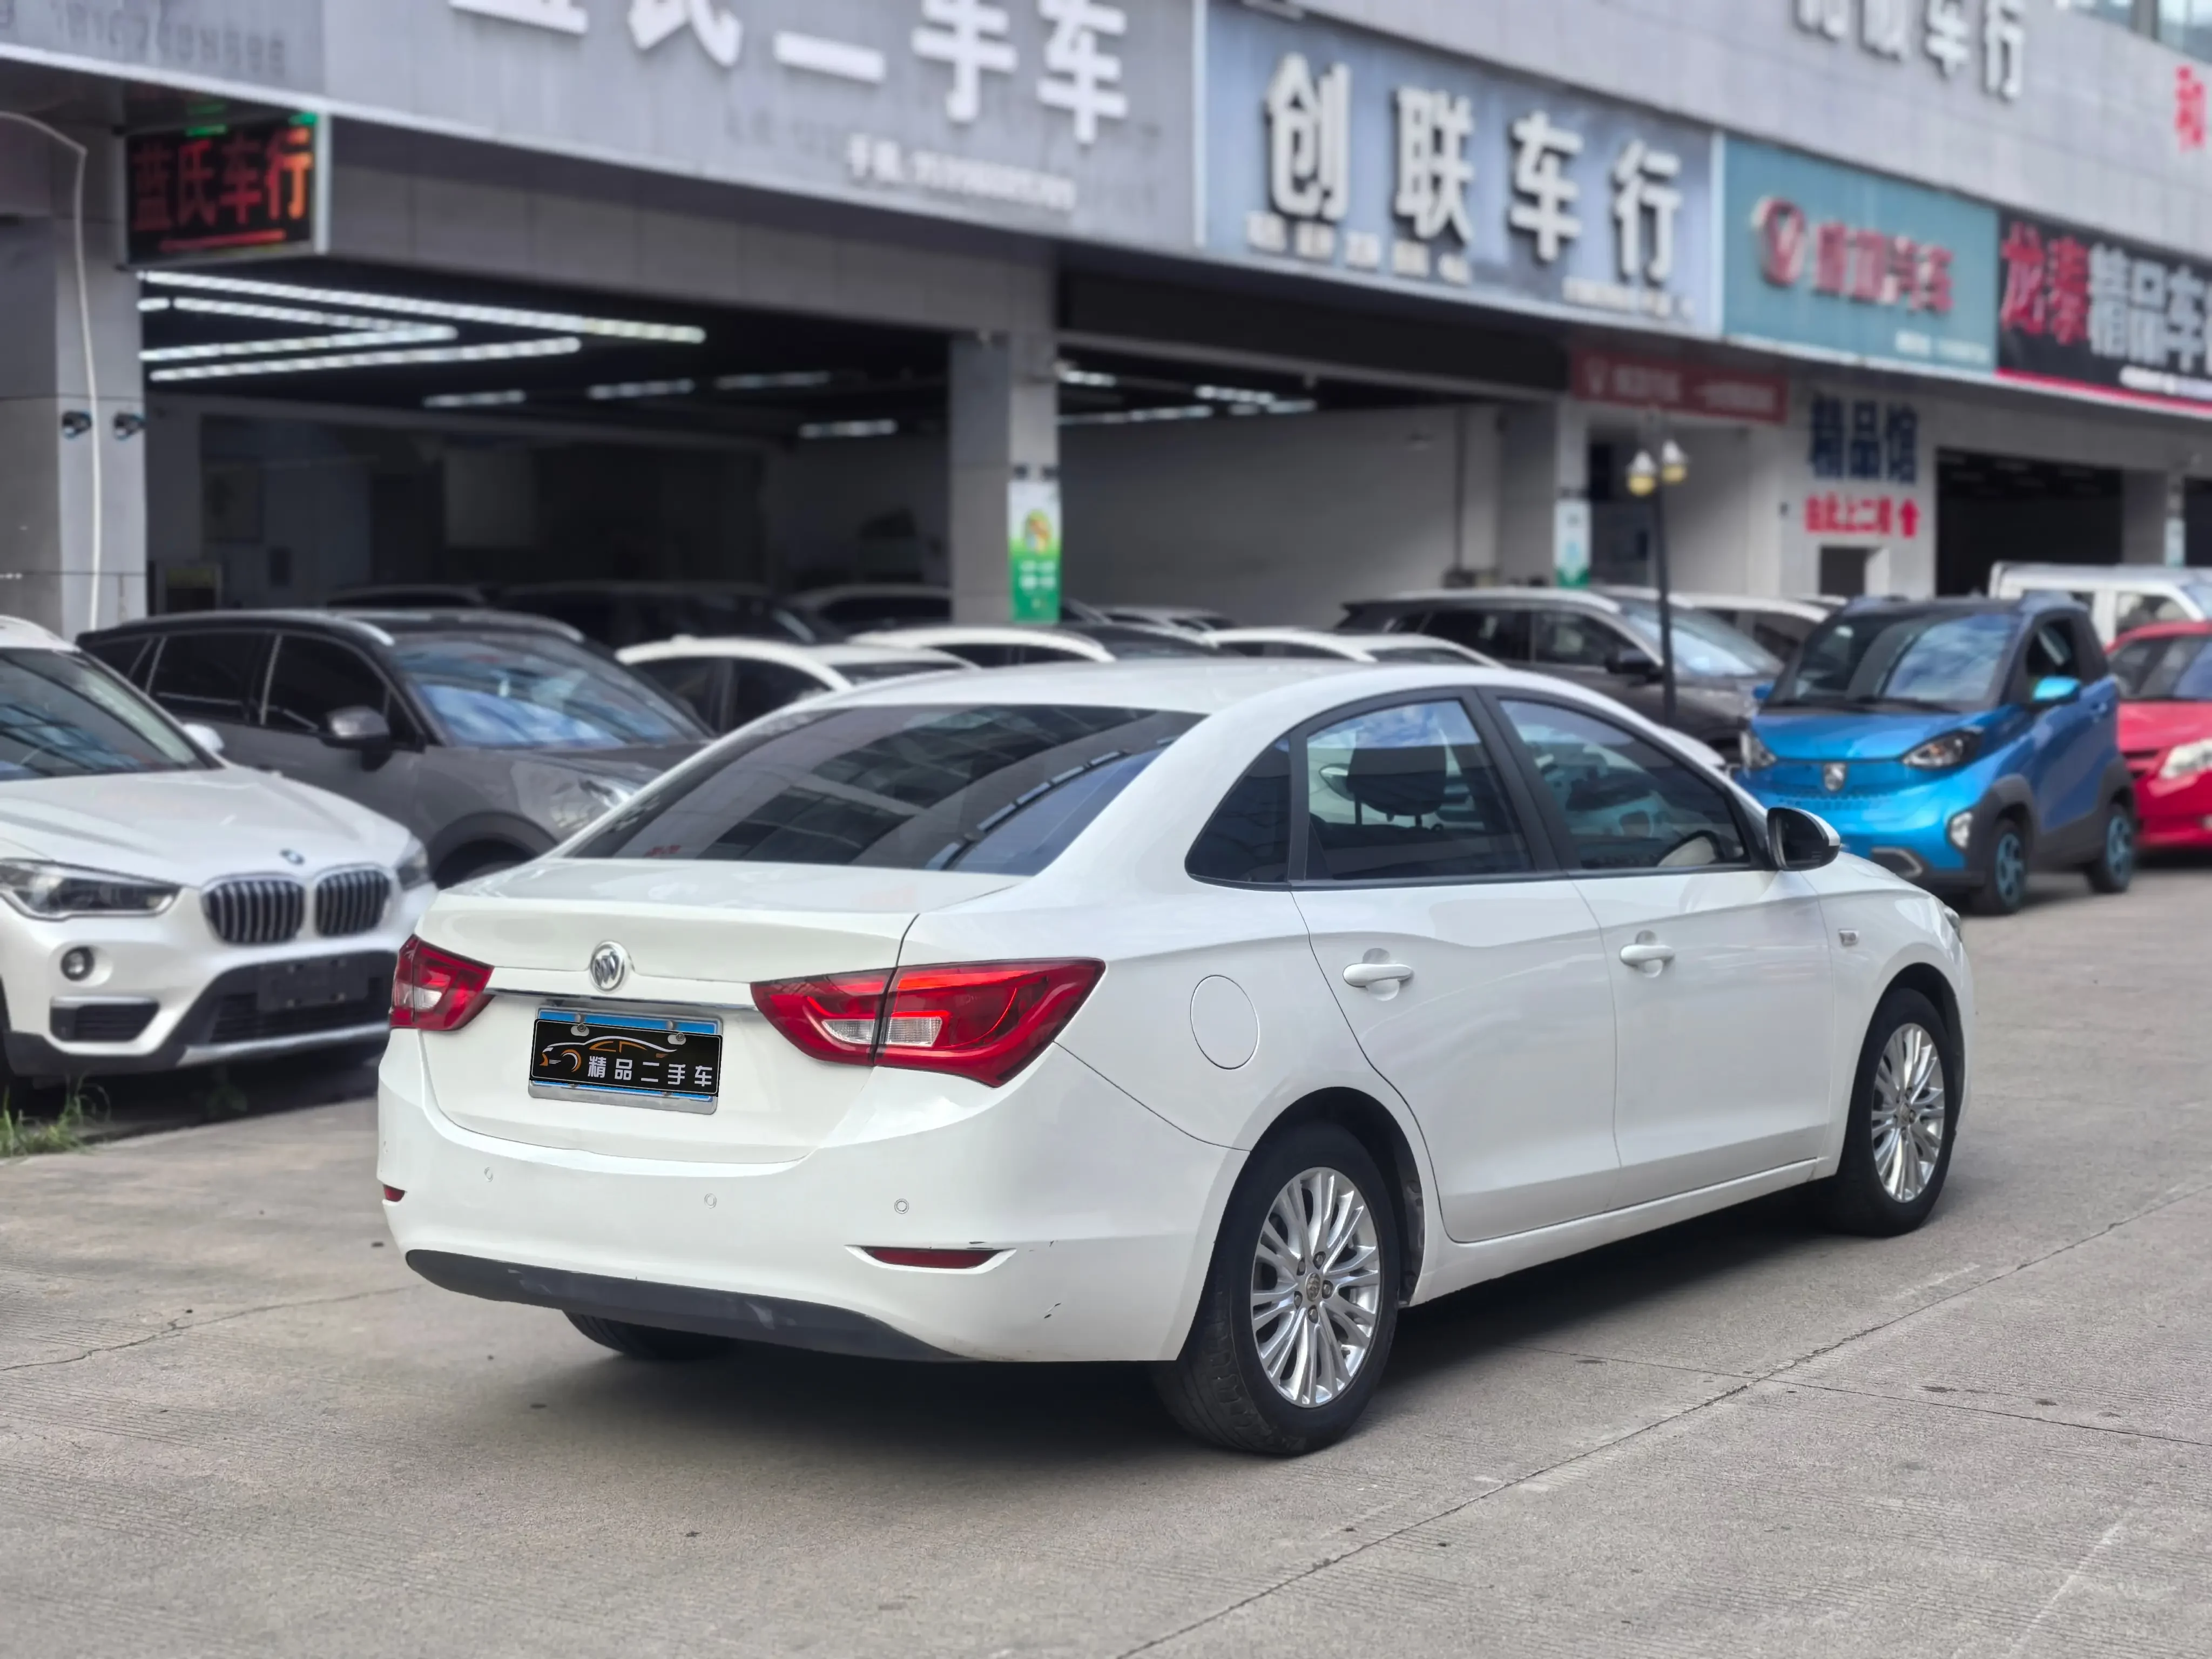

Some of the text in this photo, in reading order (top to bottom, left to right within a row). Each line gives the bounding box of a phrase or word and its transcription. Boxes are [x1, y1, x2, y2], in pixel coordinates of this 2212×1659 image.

[1267, 52, 1682, 281] 创联车行
[588, 1055, 713, 1087] 精品二手车
